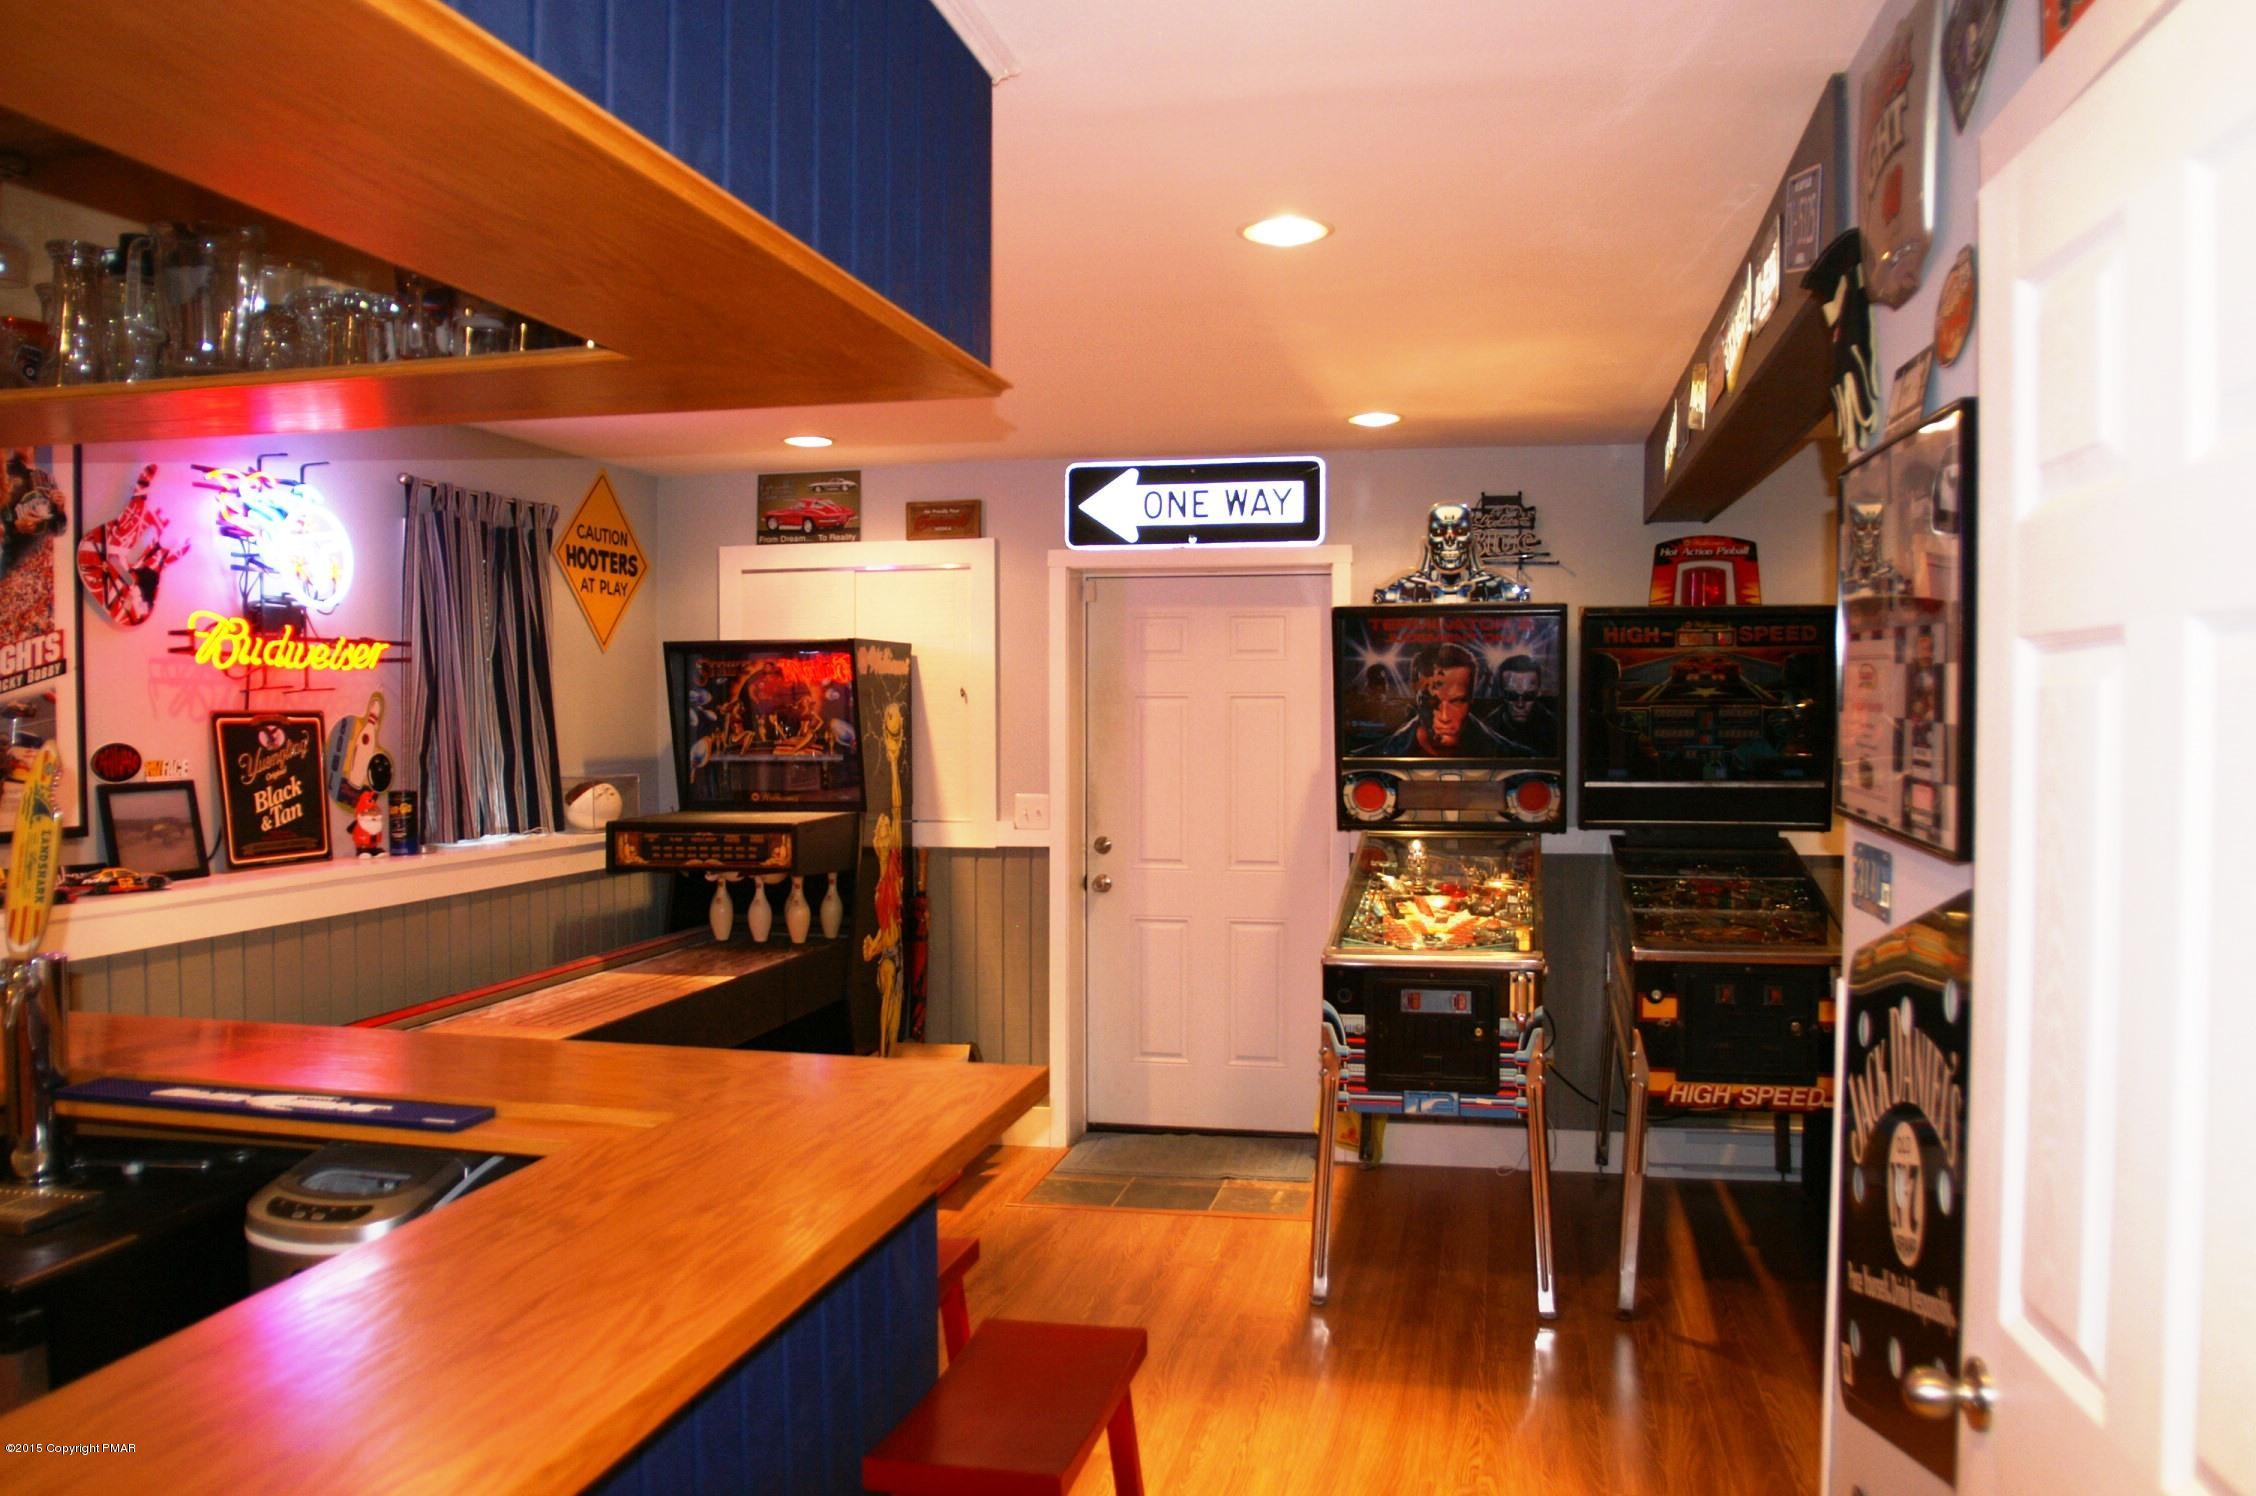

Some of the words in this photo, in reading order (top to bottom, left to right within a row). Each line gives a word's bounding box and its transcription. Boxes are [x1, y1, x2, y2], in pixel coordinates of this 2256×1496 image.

[1144, 490, 1208, 519] ONE
[1225, 488, 1292, 516] WAY
[576, 524, 628, 547] CAUTION
[759, 535, 778, 543] From
[829, 533, 856, 541] Reality
[566, 544, 638, 577] HOOTERS
[1660, 548, 1677, 556] Hot
[1682, 547, 1713, 556] Action
[1716, 546, 1749, 555] Pinball
[581, 578, 595, 593] AT
[600, 580, 628, 597] PLAY
[187, 609, 390, 671] Budweiser
[1739, 625, 1818, 643] SPEED
[27, 662, 62, 684] BOBBY
[254, 775, 303, 813] Black
[270, 803, 303, 828] Tan
[35, 829, 52, 904] LANDSHARK
[1669, 1083, 1731, 1104] HIGH
[1739, 1086, 1826, 1107] SPEED
[1848, 1039, 1891, 1164] JACK
